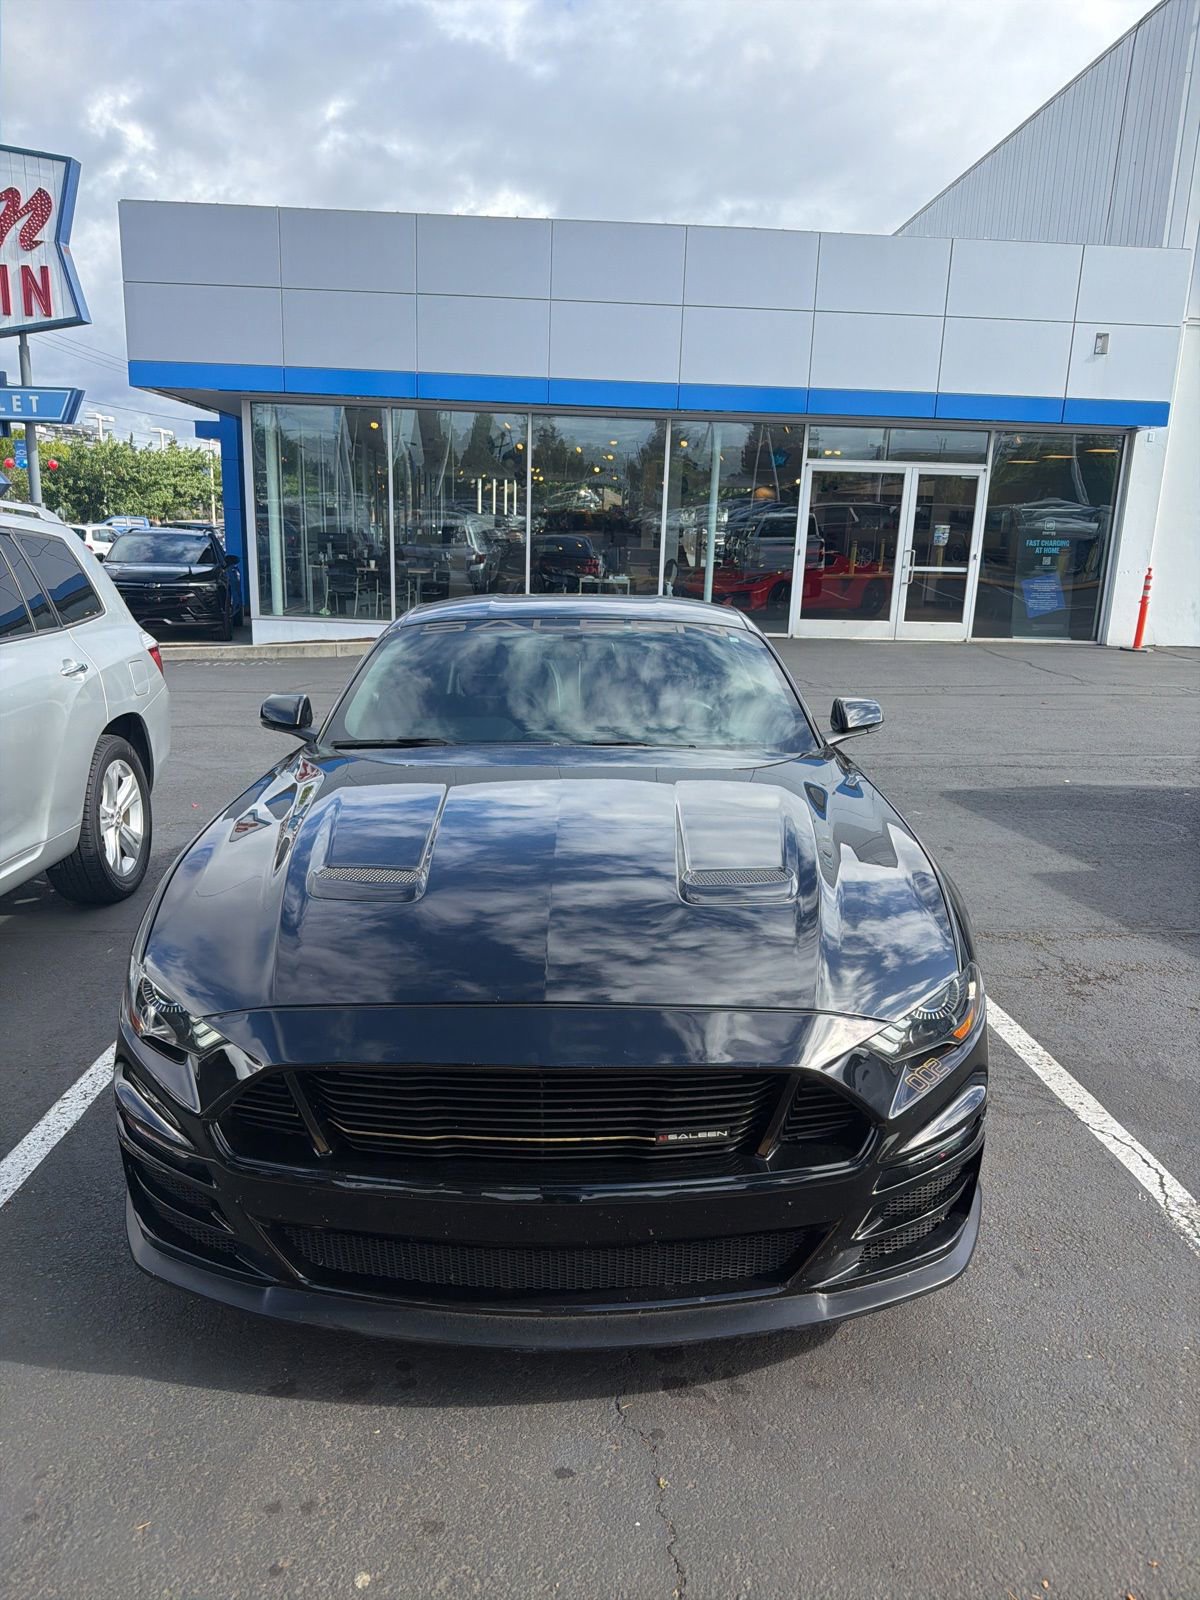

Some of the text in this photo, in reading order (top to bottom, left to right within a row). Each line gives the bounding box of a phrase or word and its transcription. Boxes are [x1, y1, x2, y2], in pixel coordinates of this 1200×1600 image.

[1026, 539, 1069, 547] FAST CHARGING
[420, 619, 728, 637] SALEEN
[905, 1057, 951, 1093] 002
[668, 1130, 728, 1140] SALEEN
